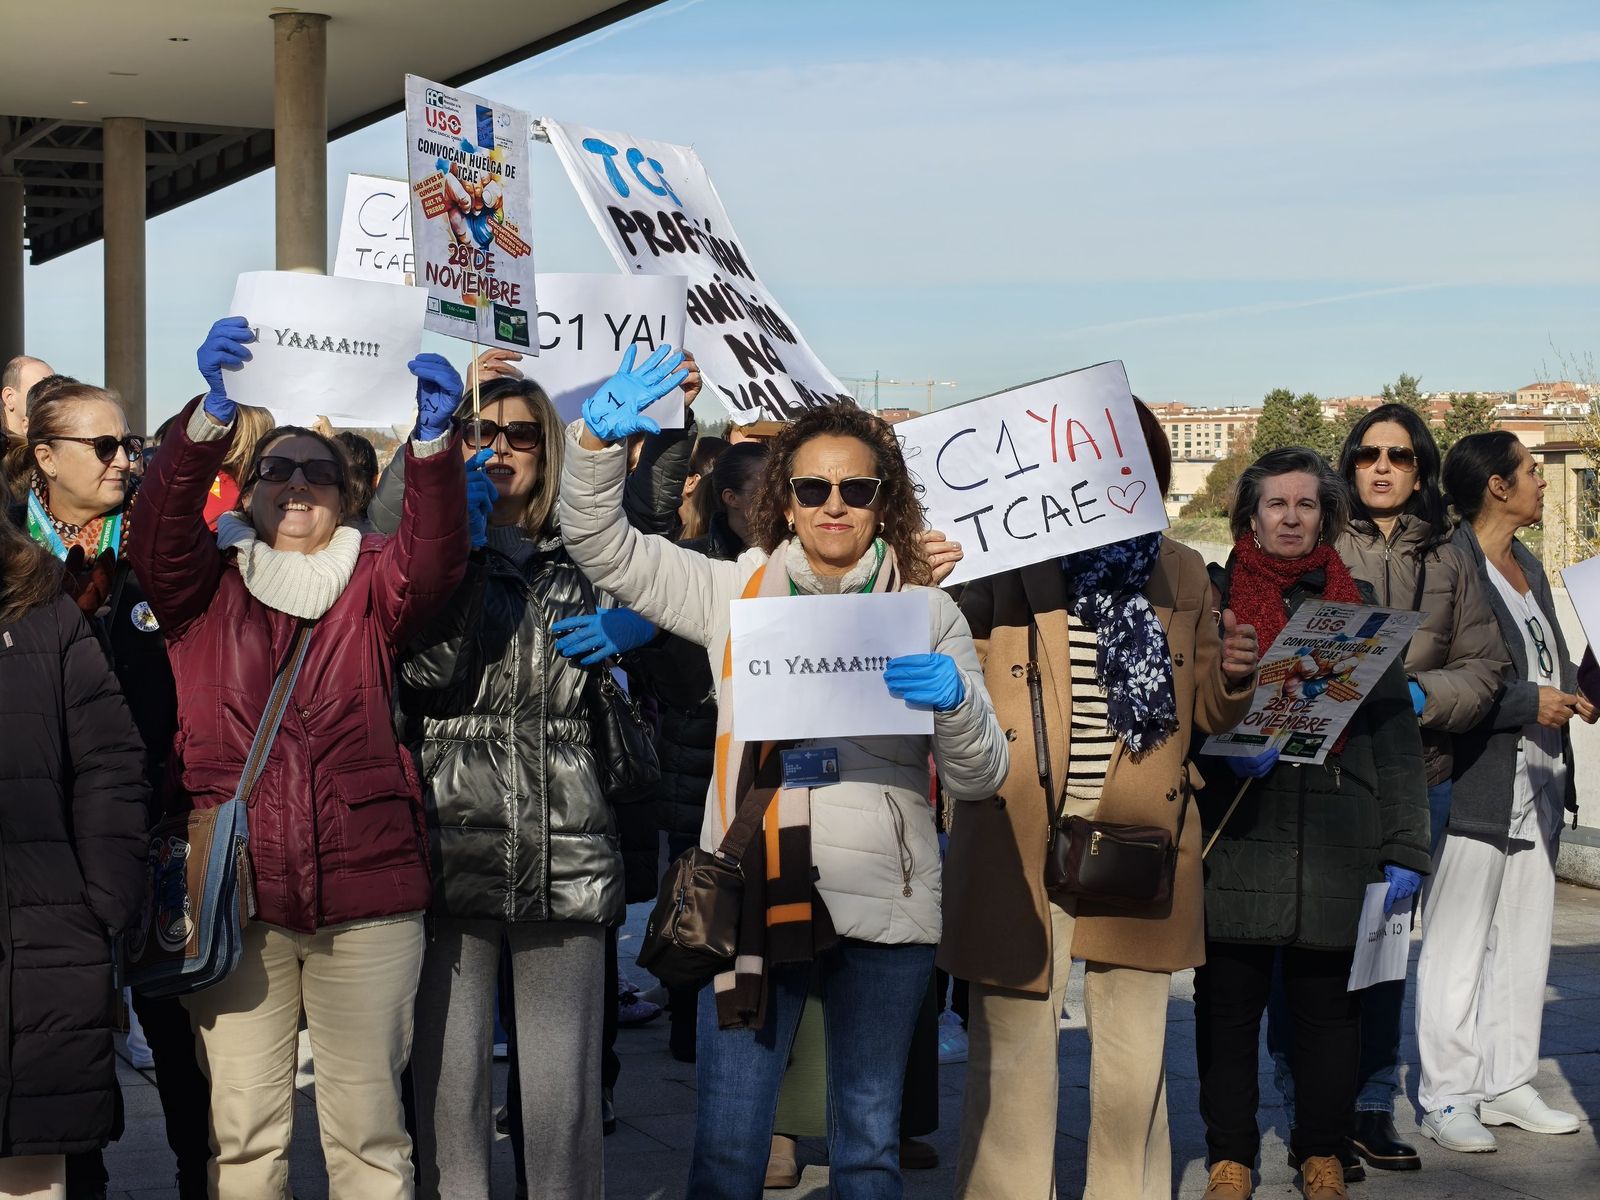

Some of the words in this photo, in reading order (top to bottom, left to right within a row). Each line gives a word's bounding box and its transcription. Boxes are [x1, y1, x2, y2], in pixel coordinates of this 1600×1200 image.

[425, 106, 461, 135] USO
[418, 138, 466, 165] CONVOCAN
[469, 154, 502, 175] HUELGA
[505, 163, 516, 179] DE
[457, 165, 479, 184] TCAE
[358, 192, 409, 241] C1
[355, 247, 416, 274] TCAE
[448, 243, 469, 267] 28
[473, 248, 496, 273] DE
[425, 260, 521, 307] NOVIEMBRE
[274, 327, 381, 358] YAAAA!!!!
[537, 311, 583, 350] C1
[723, 331, 787, 379] NO
[936, 419, 1040, 491] C1
[1025, 404, 1132, 476] YA!
[953, 479, 1106, 553] TCAE
[1306, 617, 1346, 631] USO
[1282, 636, 1335, 651] CONVOCAN
[1335, 640, 1370, 655] HUELGA
[1370, 646, 1388, 656] DE
[1319, 649, 1341, 661] TCAE
[748, 659, 772, 676] C1
[1263, 697, 1288, 711] 28
[1289, 699, 1319, 713] DE
[1244, 712, 1332, 734] OVIEMBRE
